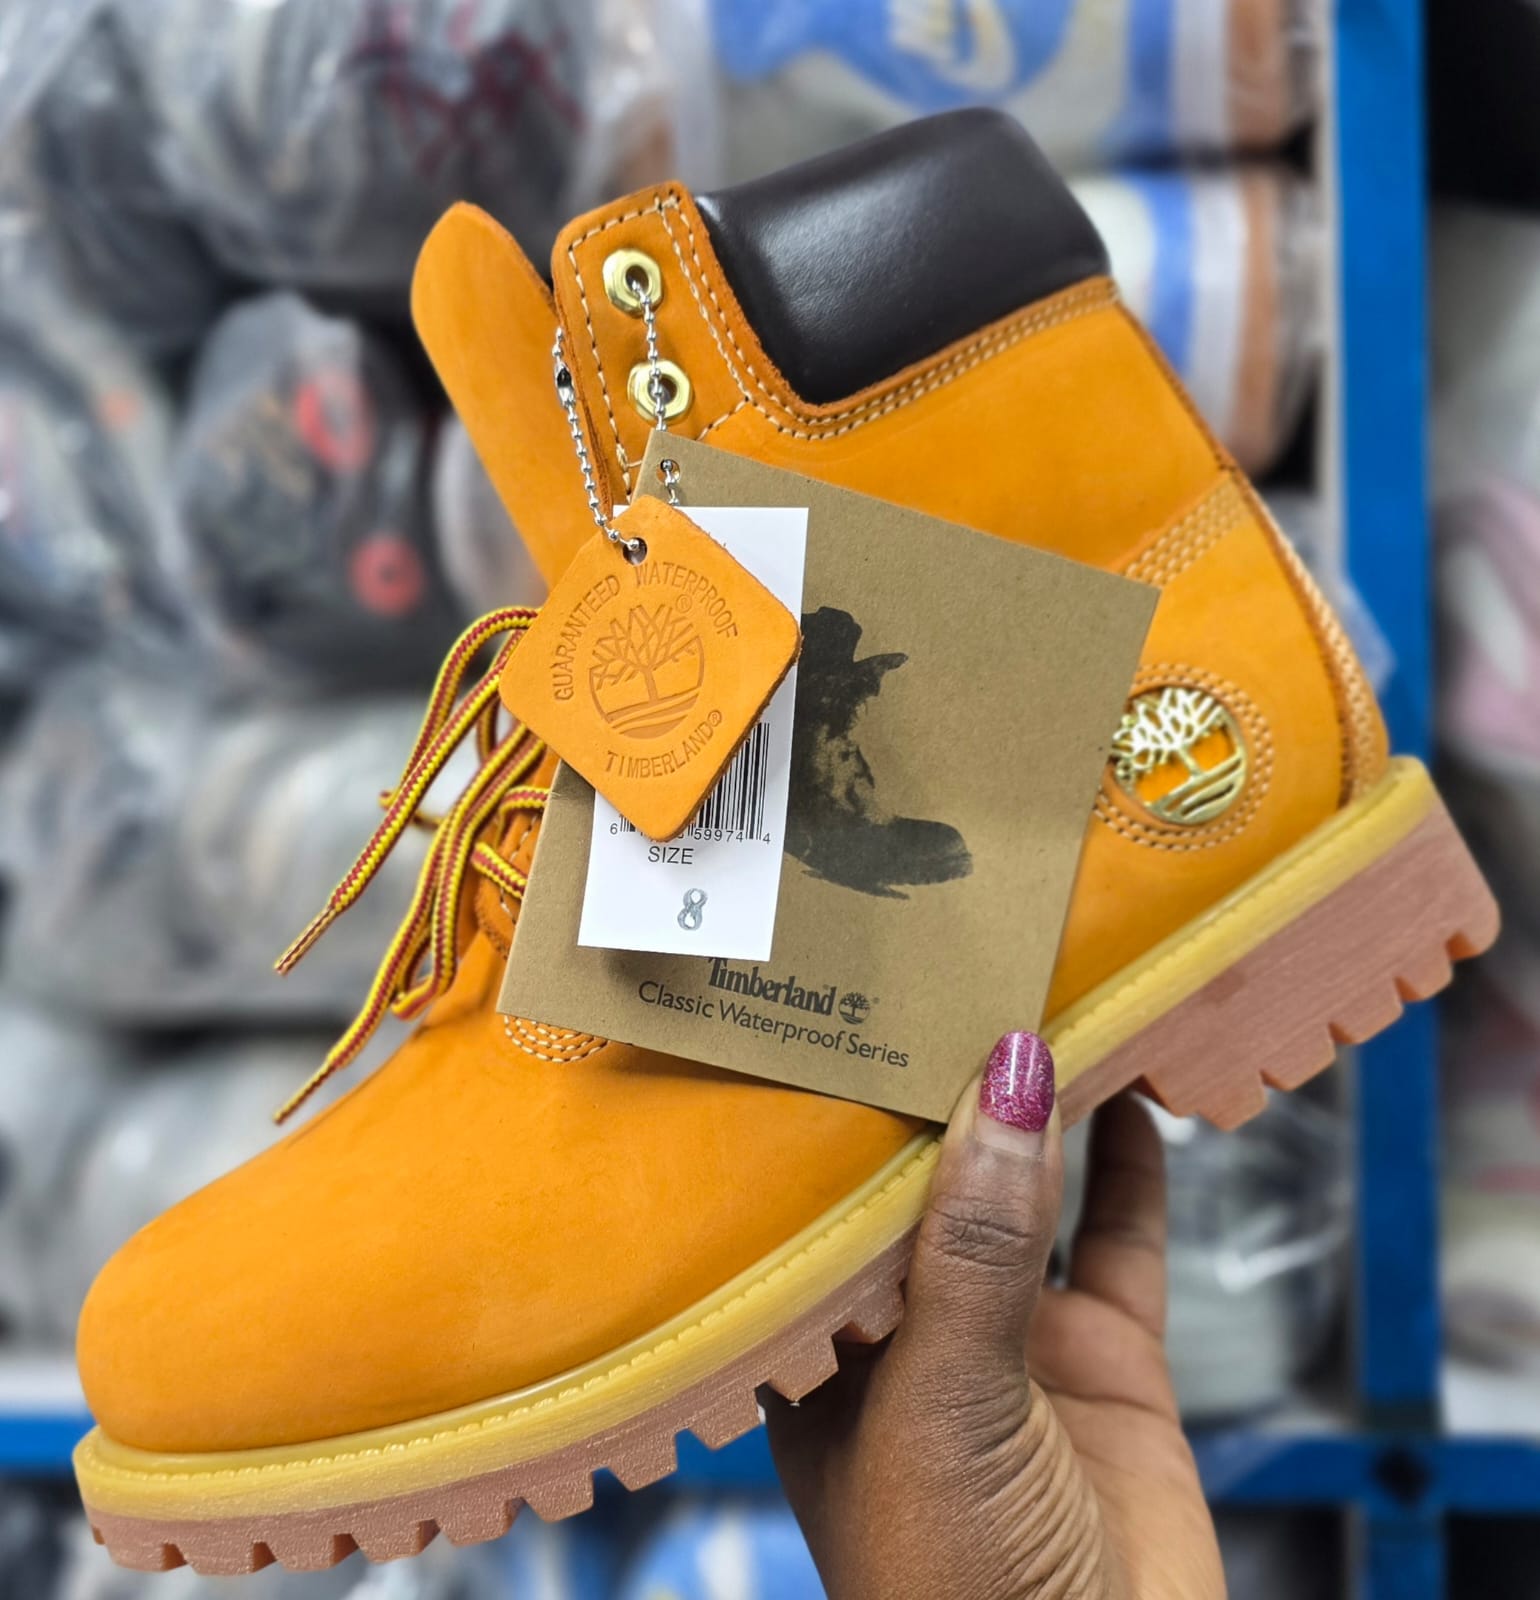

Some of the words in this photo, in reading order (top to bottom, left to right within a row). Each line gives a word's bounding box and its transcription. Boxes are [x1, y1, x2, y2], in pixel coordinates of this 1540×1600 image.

[553, 574, 621, 701] GUARANTEED
[634, 561, 738, 640] WATERPROOF
[648, 845, 694, 865] SIZE
[694, 828, 743, 843] 59974
[762, 832, 771, 845] 4
[677, 888, 708, 931] 8
[708, 957, 837, 1016] Timberland
[638, 980, 714, 1018] Classic
[719, 1000, 845, 1051] Waterproof
[849, 1033, 909, 1068] Series
